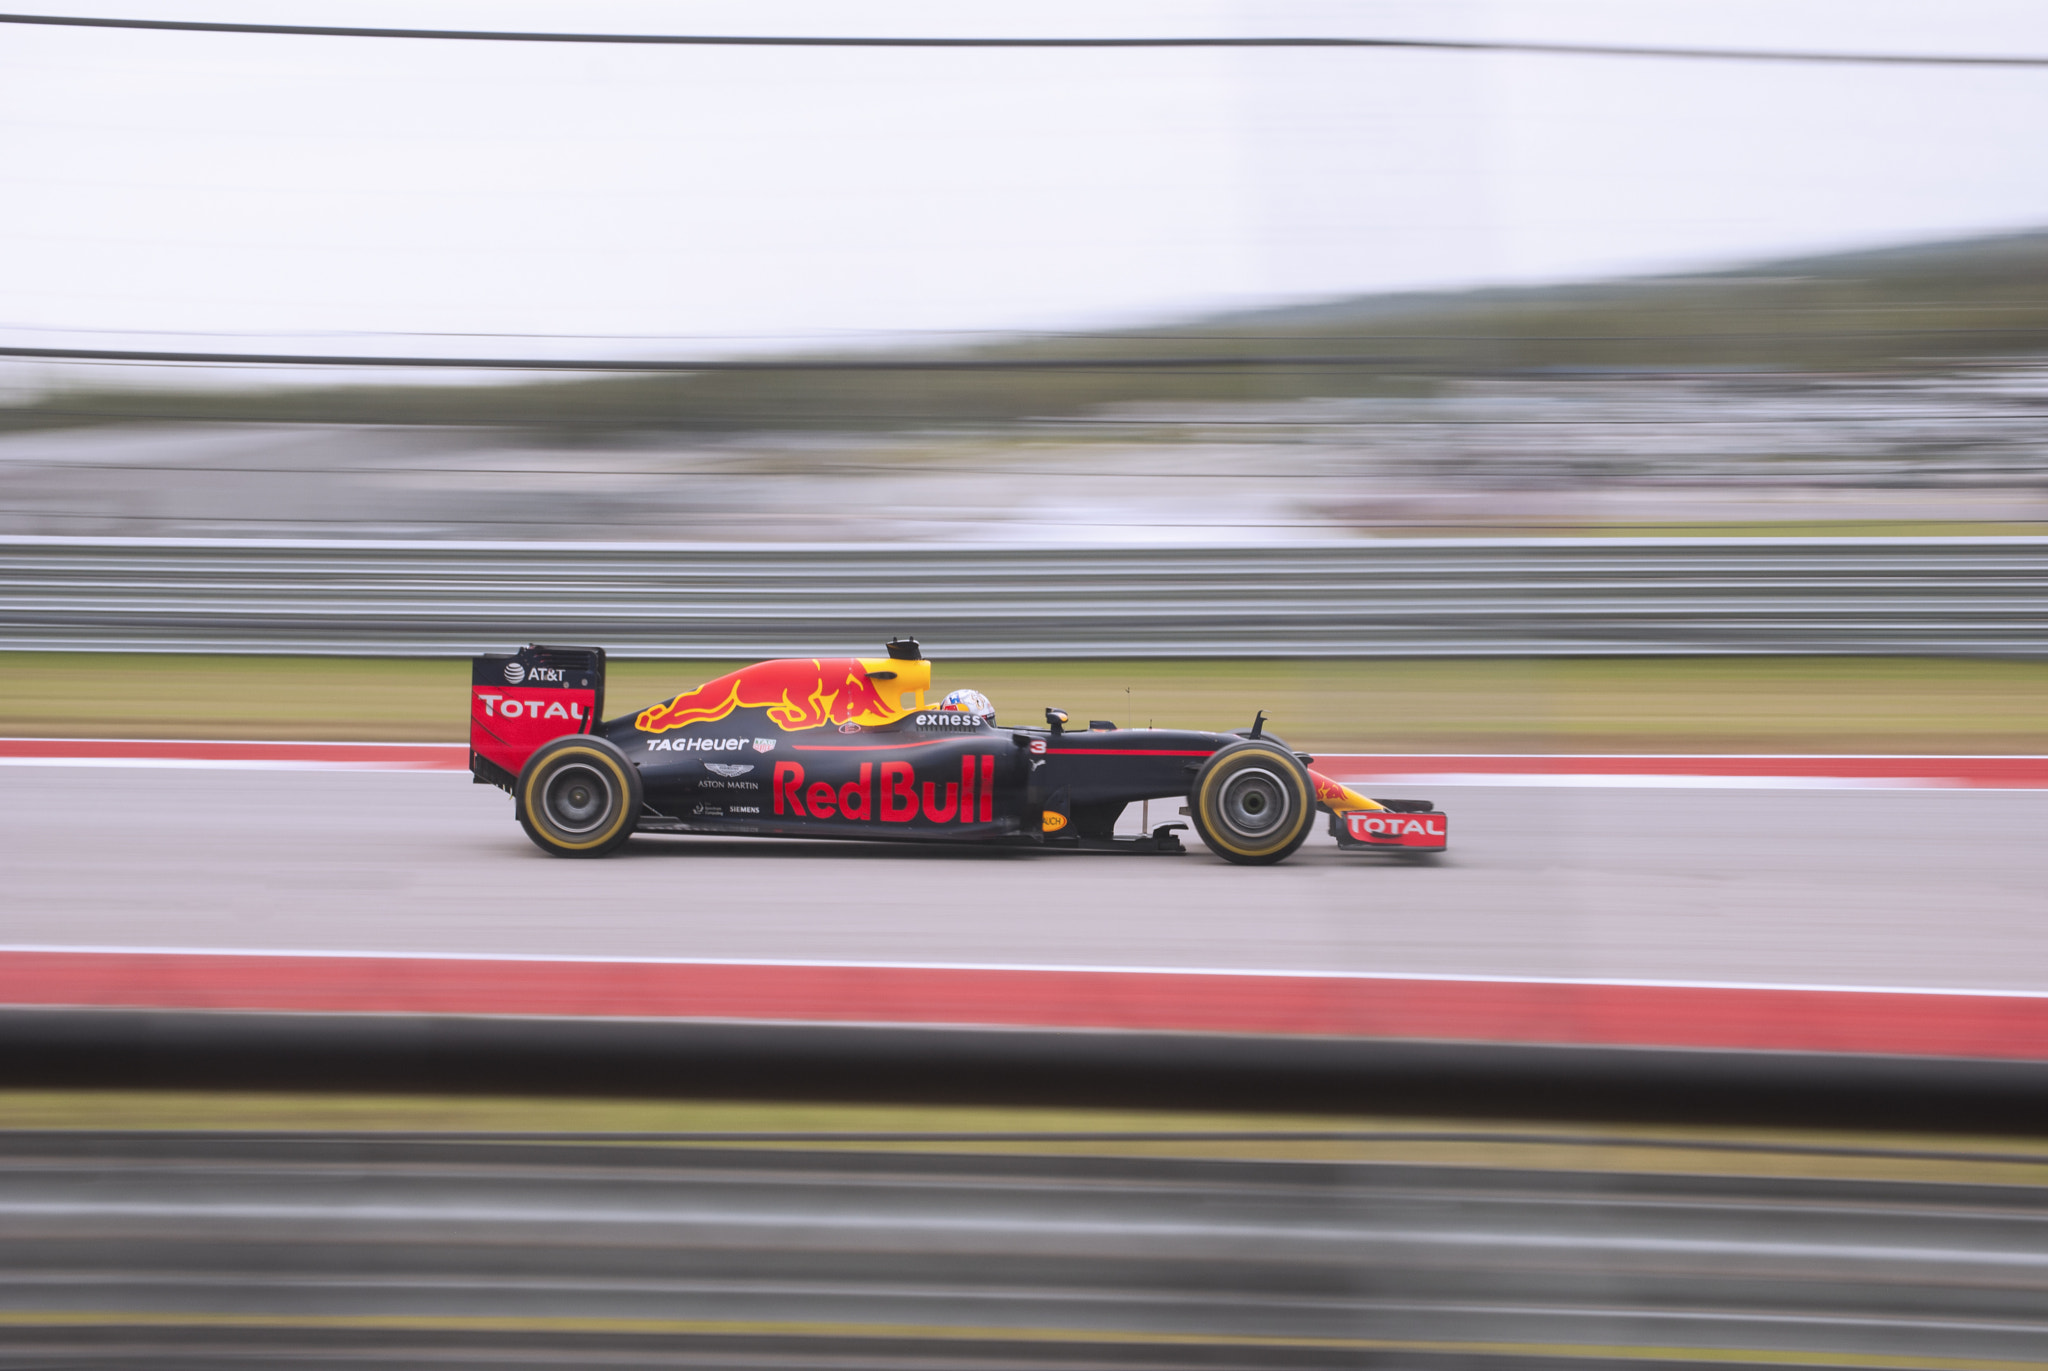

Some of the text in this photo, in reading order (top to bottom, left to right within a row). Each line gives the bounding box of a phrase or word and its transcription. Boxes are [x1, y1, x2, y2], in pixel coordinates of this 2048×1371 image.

[528, 668, 566, 682] AT&T
[478, 695, 591, 720] TOTAL
[916, 714, 981, 726] exness
[1030, 740, 1047, 754] 3
[698, 780, 759, 790] ASTON MARTIN
[729, 806, 760, 814] SIEMENS
[1042, 816, 1062, 826] AUCH
[1348, 815, 1446, 835] TOTAL
